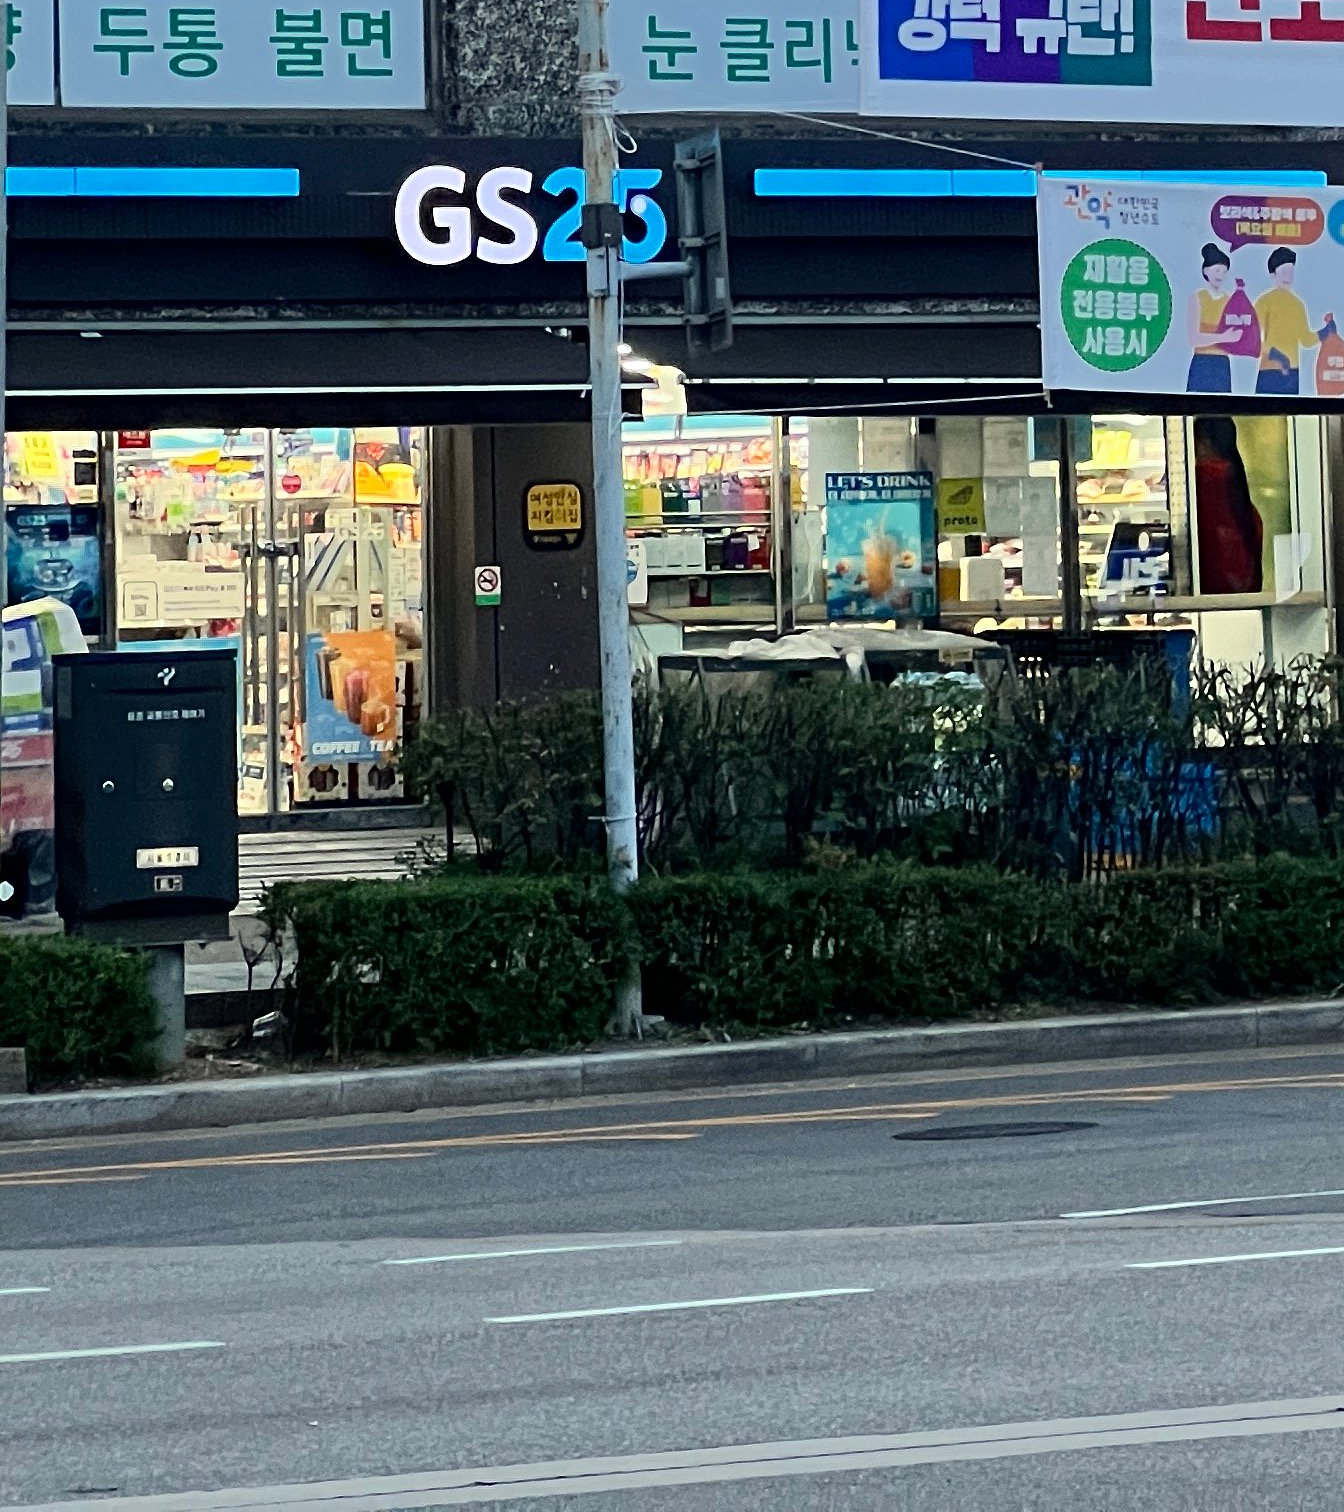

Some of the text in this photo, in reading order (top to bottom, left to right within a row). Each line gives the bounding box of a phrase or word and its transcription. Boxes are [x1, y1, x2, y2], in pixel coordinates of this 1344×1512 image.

[93, 8, 224, 78] 두통
[270, 8, 394, 78] 불면
[642, 15, 698, 81] 눈
[395, 165, 668, 266] GS25
[1083, 254, 1150, 285] 재활용
[1073, 290, 1159, 320] 전용봉투
[1082, 327, 1148, 357] 사용시
